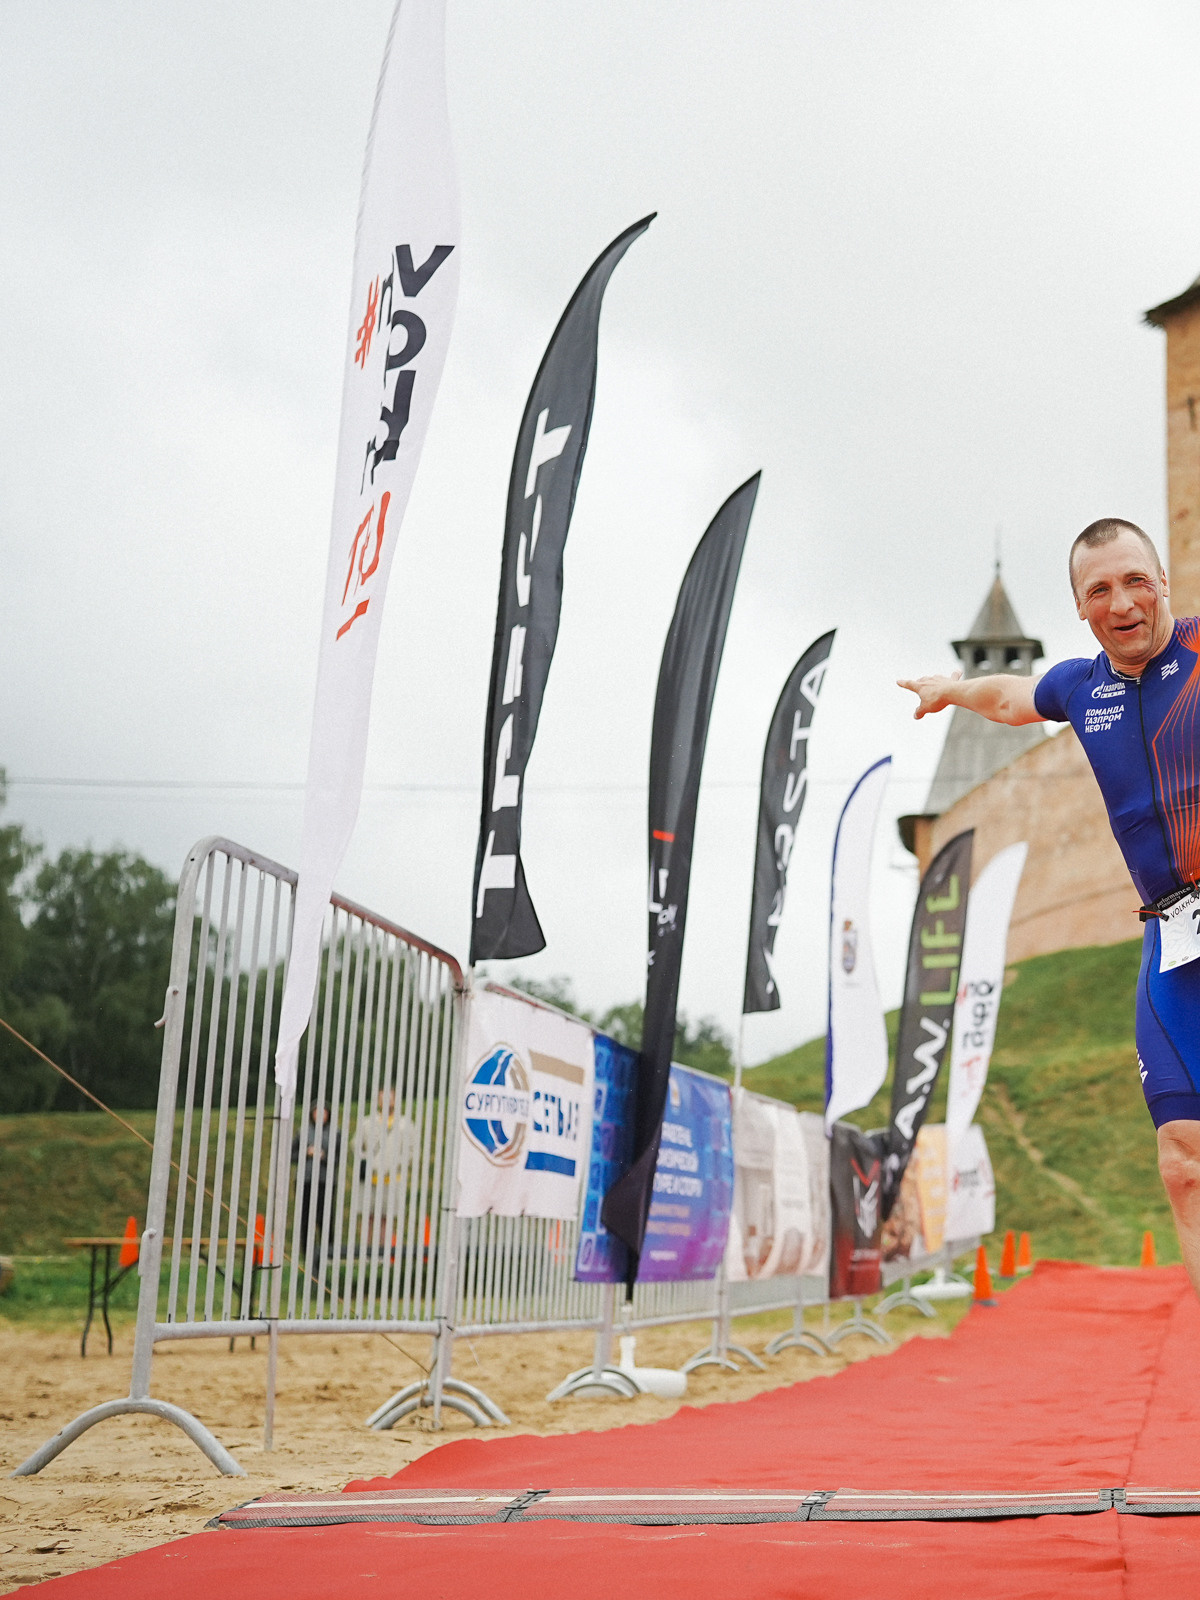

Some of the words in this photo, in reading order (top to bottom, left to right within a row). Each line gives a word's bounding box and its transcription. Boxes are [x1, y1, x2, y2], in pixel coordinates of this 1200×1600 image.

[1085, 704, 1124, 717] КОМАНДА
[1085, 712, 1122, 725] ГАЗПРОМ
[1085, 722, 1112, 734] НЕФТИ
[919, 873, 961, 1006] LIFE
